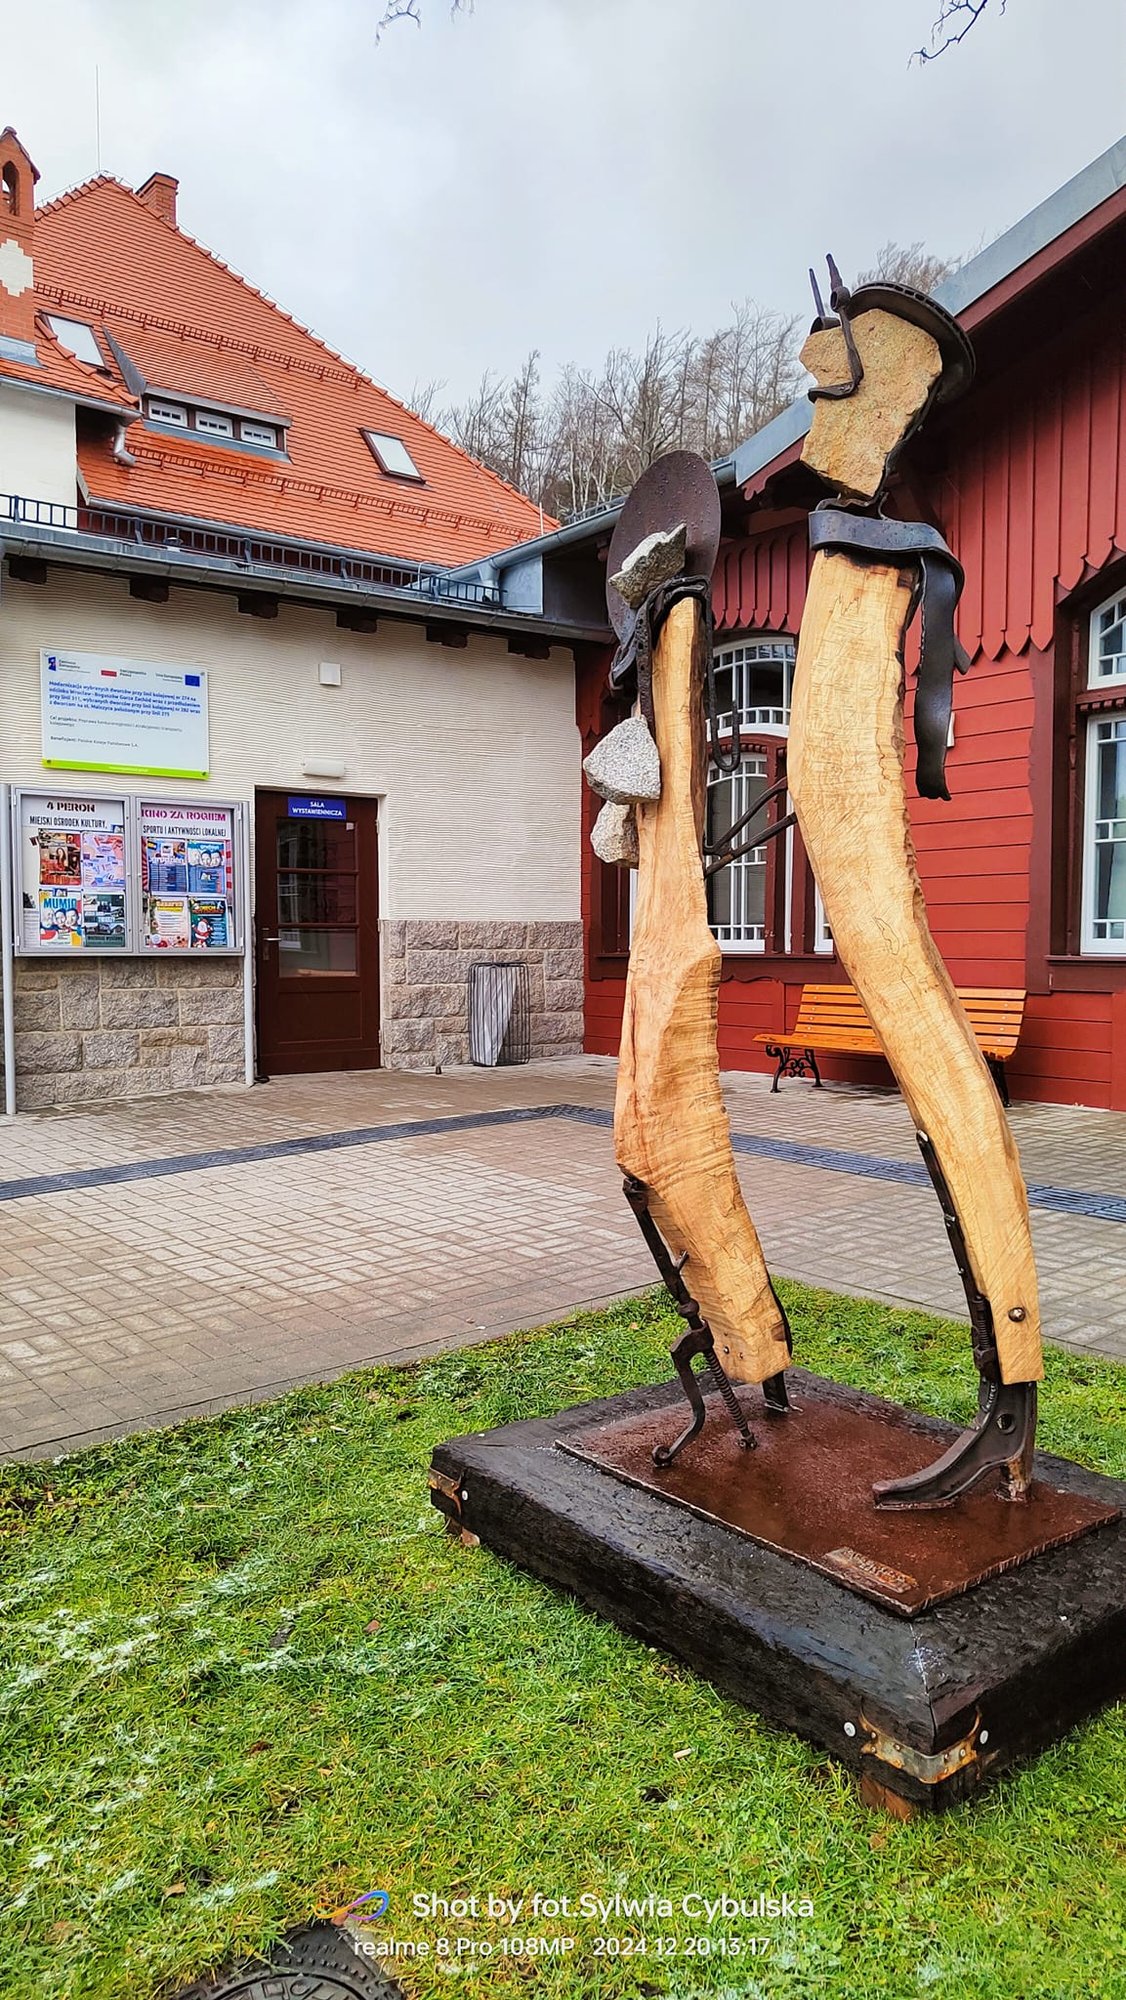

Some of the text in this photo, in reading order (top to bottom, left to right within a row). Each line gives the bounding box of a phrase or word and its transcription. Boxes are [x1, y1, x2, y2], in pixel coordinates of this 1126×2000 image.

[47, 801, 95, 813] 4 PERON
[292, 807, 342, 816] WYSTAWIENNICZA
[29, 815, 52, 825] MIEJSKI
[141, 809, 226, 821] KINO ZA ROGIEM
[143, 825, 163, 833] SPORTU
[168, 825, 200, 835] AKTYWNOŚCI
[202, 828, 226, 836] LOKALNEJ
